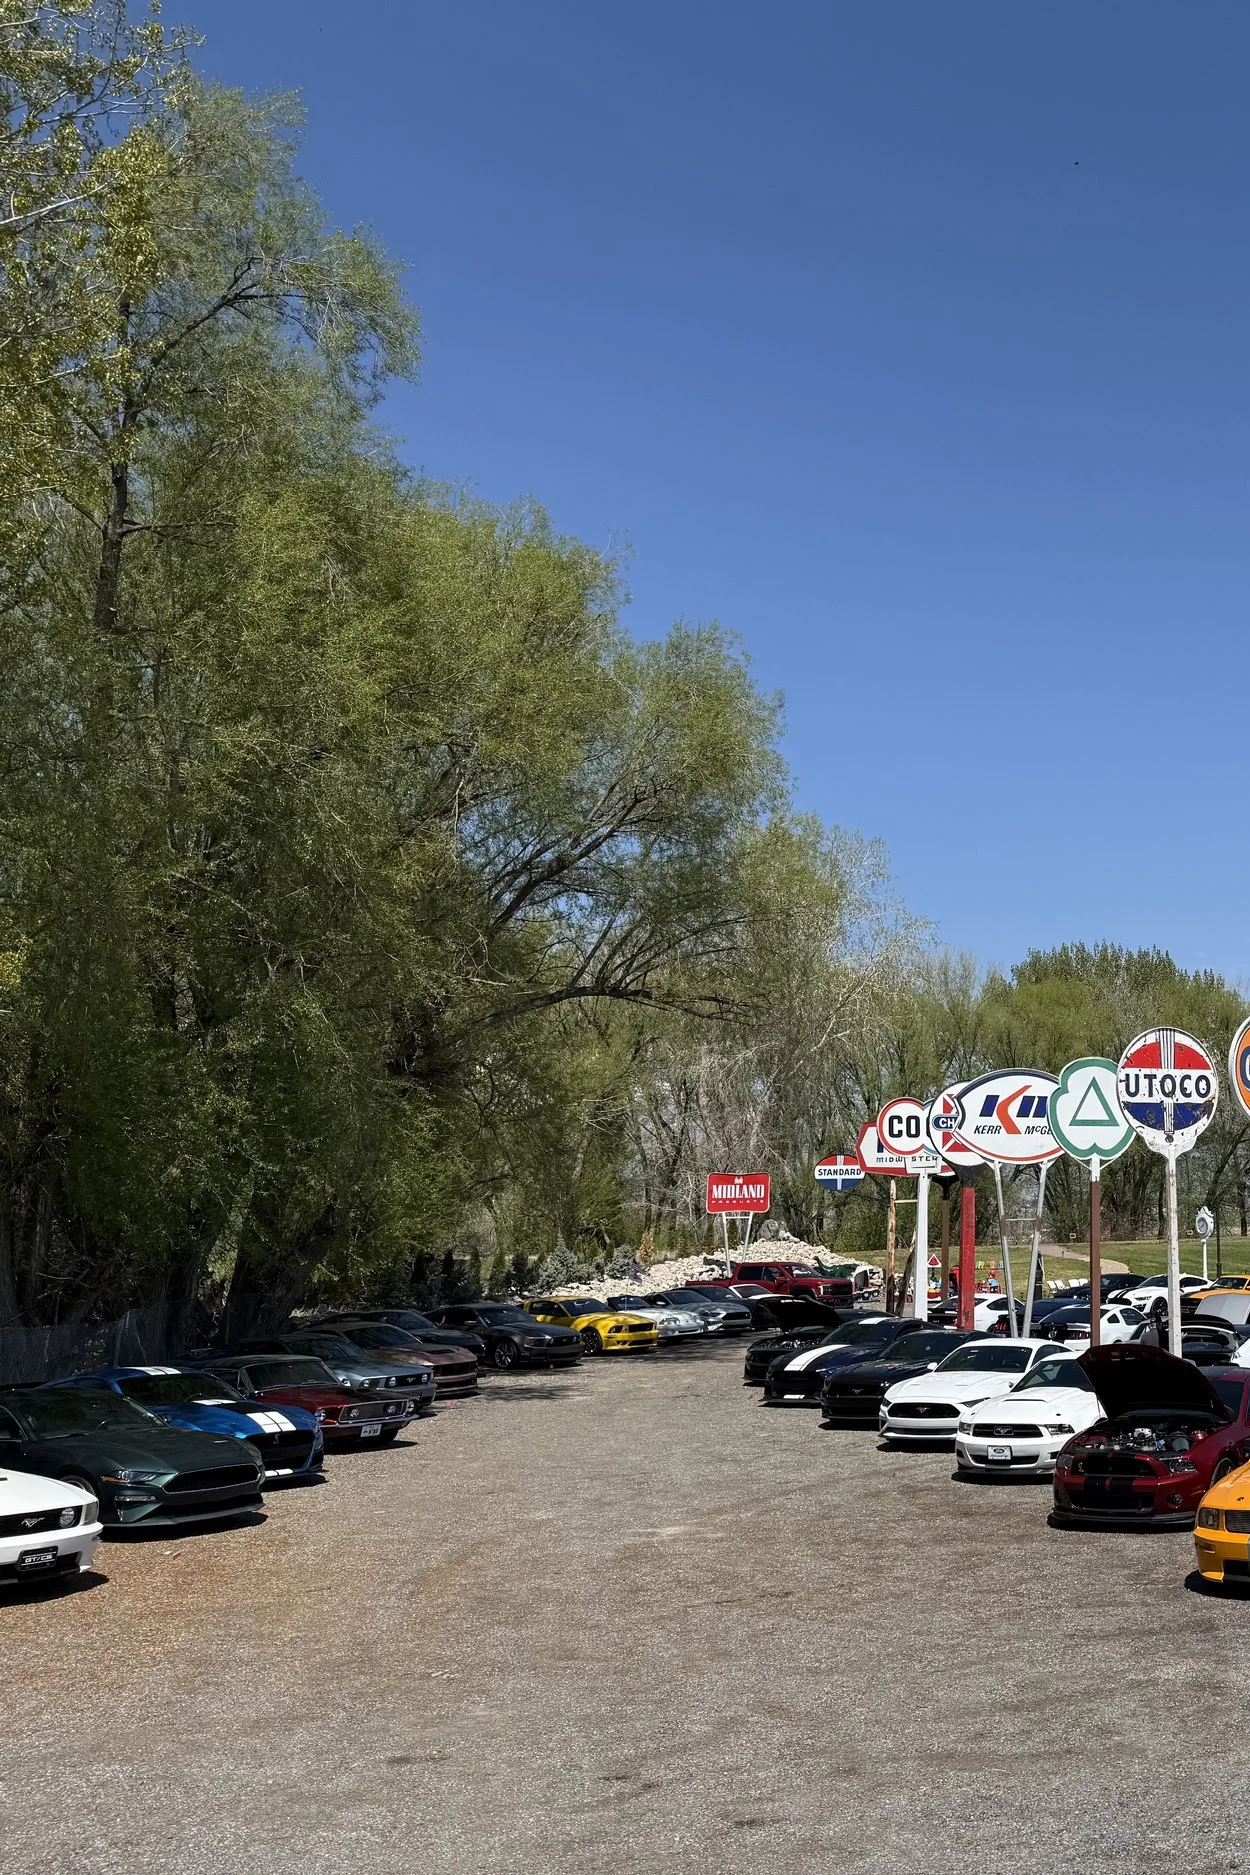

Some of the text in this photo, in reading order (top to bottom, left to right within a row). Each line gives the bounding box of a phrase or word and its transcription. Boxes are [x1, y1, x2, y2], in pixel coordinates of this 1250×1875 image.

[1124, 1073, 1211, 1099] UTOCO
[974, 1124, 1002, 1135] KERR
[818, 1168, 862, 1176] STANDARD
[712, 1184, 765, 1199] MIDLAND
